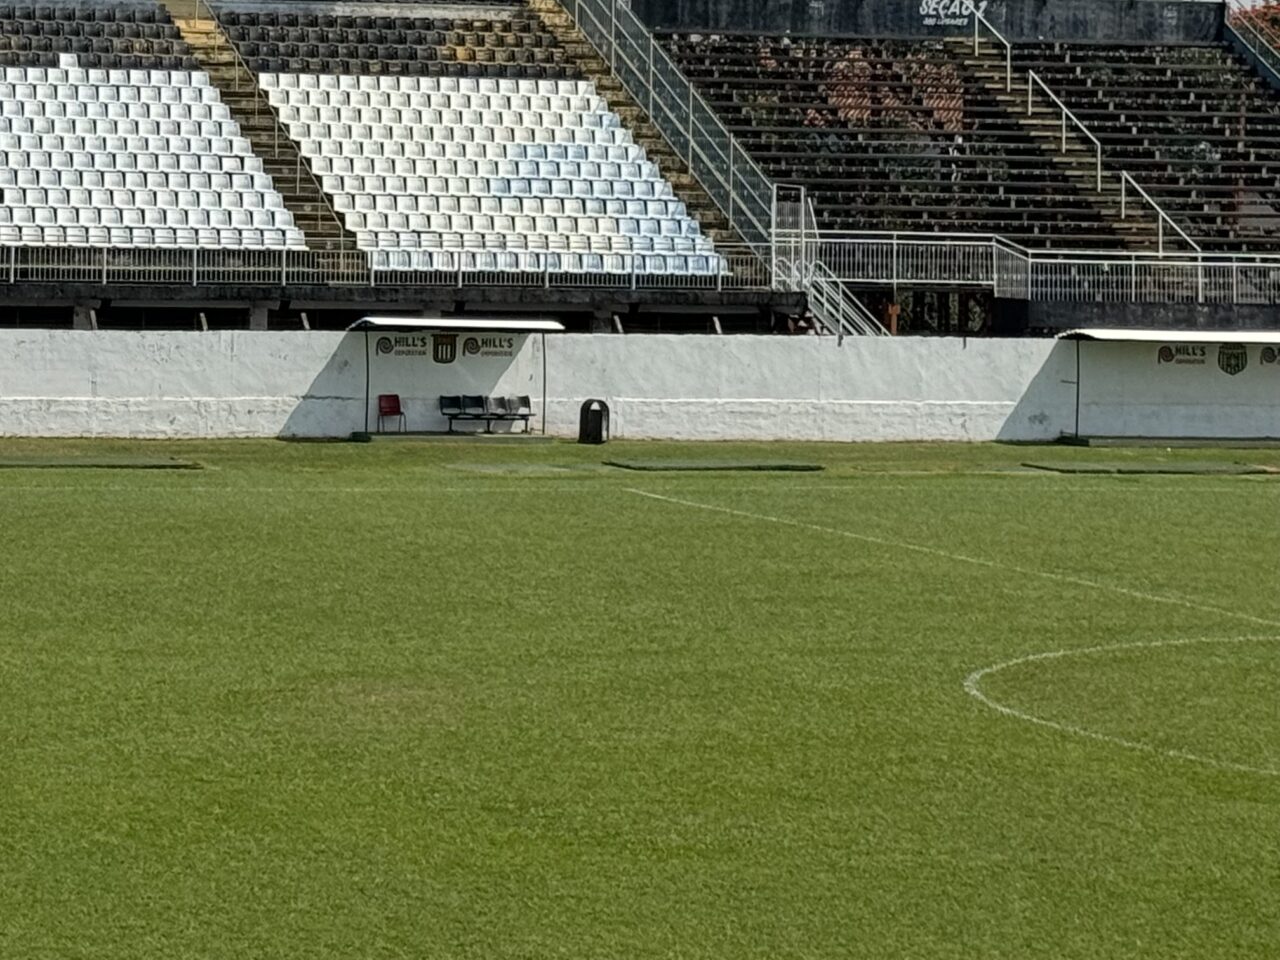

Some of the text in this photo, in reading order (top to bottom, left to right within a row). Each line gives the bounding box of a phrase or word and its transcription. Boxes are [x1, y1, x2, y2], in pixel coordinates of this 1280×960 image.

[394, 336, 427, 347] HILL'S
[481, 337, 514, 349] HILL'S
[1175, 344, 1206, 356] HILL'S
